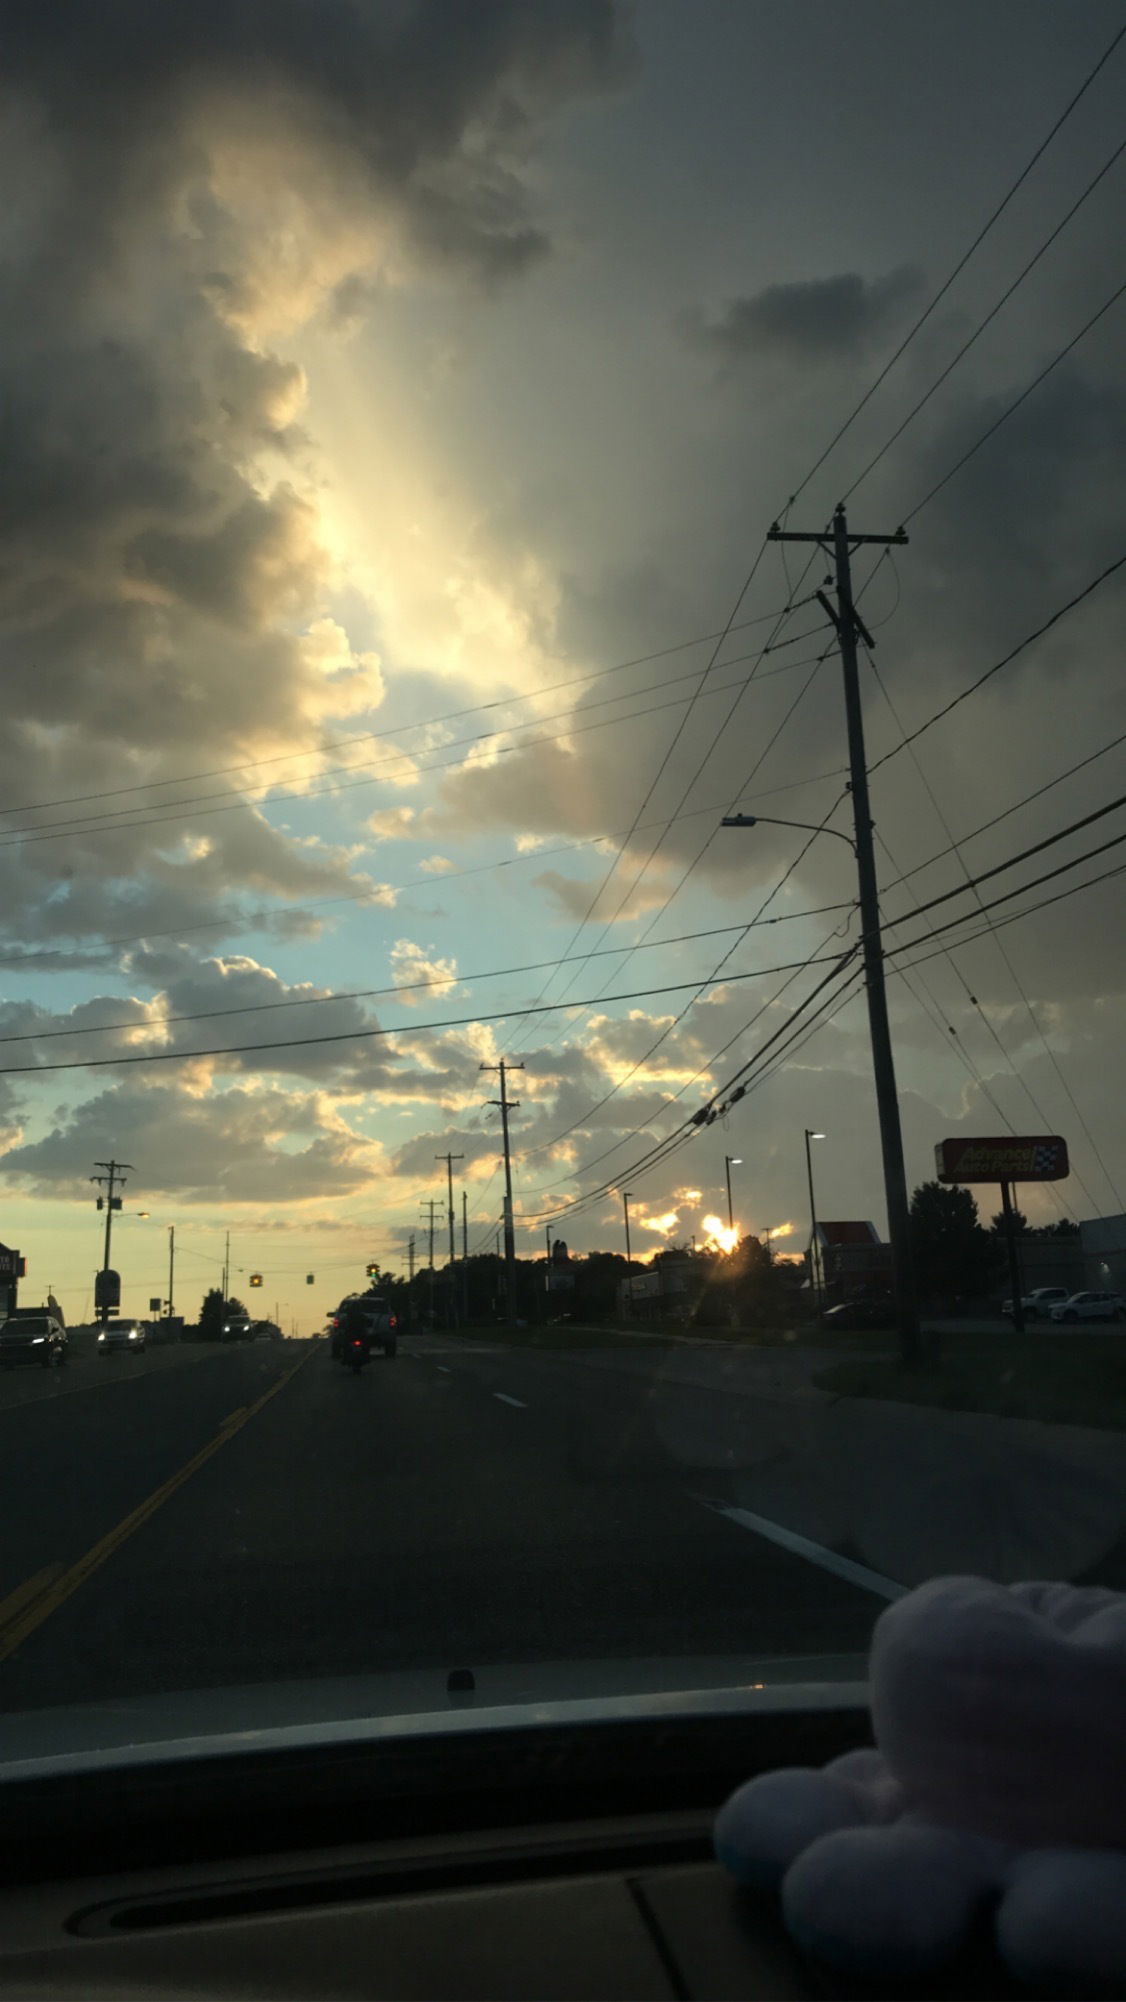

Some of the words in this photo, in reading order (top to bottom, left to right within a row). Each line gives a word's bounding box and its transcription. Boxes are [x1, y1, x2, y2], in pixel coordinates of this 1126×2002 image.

[963, 1145, 1030, 1160] Advance
[953, 1159, 988, 1173] Auto
[991, 1159, 1030, 1172] Parts
